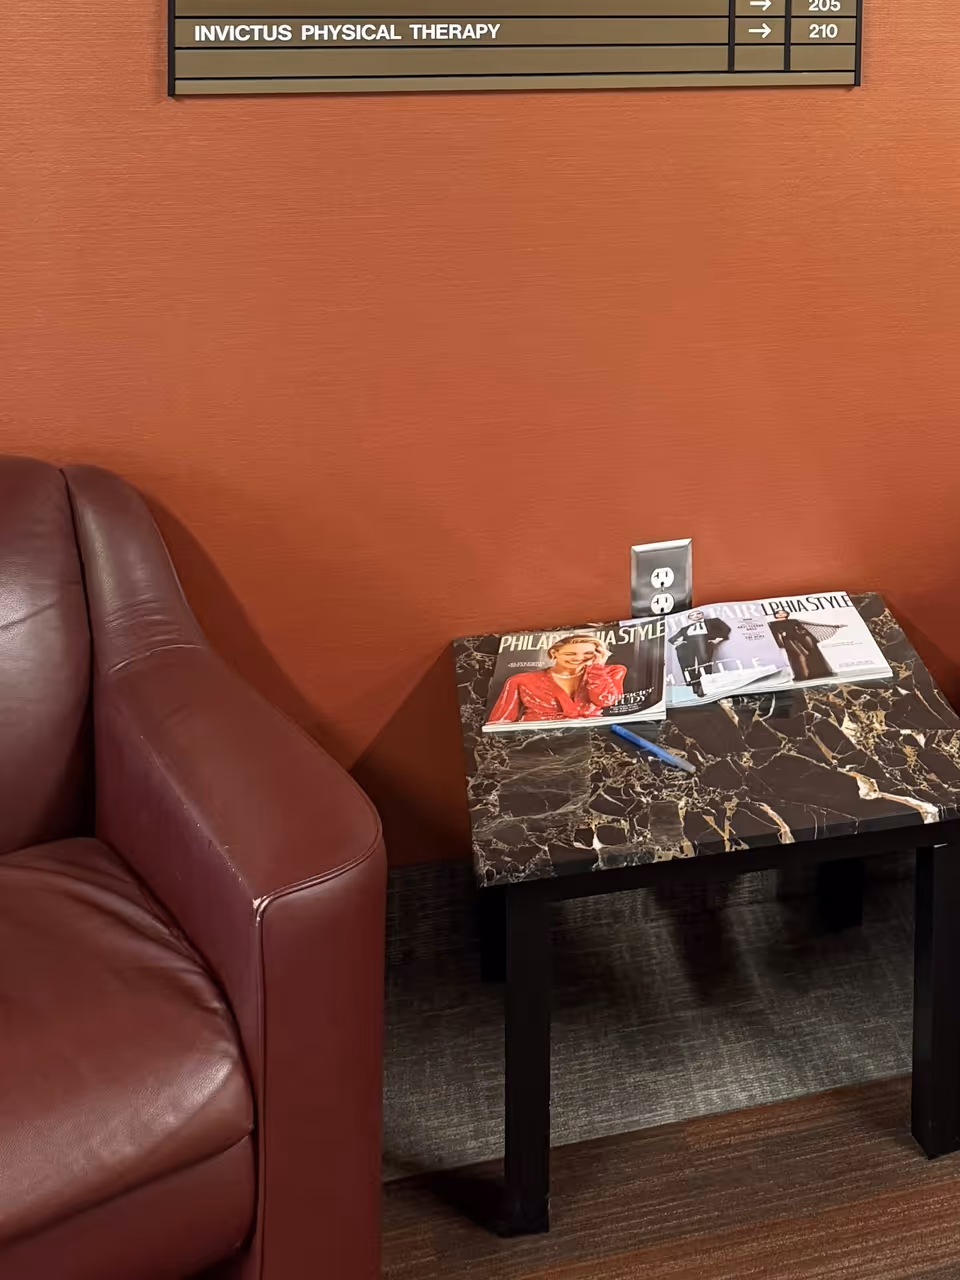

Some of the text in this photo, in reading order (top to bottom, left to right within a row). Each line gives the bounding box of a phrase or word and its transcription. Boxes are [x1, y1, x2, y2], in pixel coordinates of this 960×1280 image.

[195, 24, 500, 41] INVICTUS PHYSICAL THERAPY
[810, 24, 837, 38] 210
[806, 593, 854, 612] STYLE
[499, 631, 616, 652] PHILADIA
[617, 622, 666, 645] STYLE
